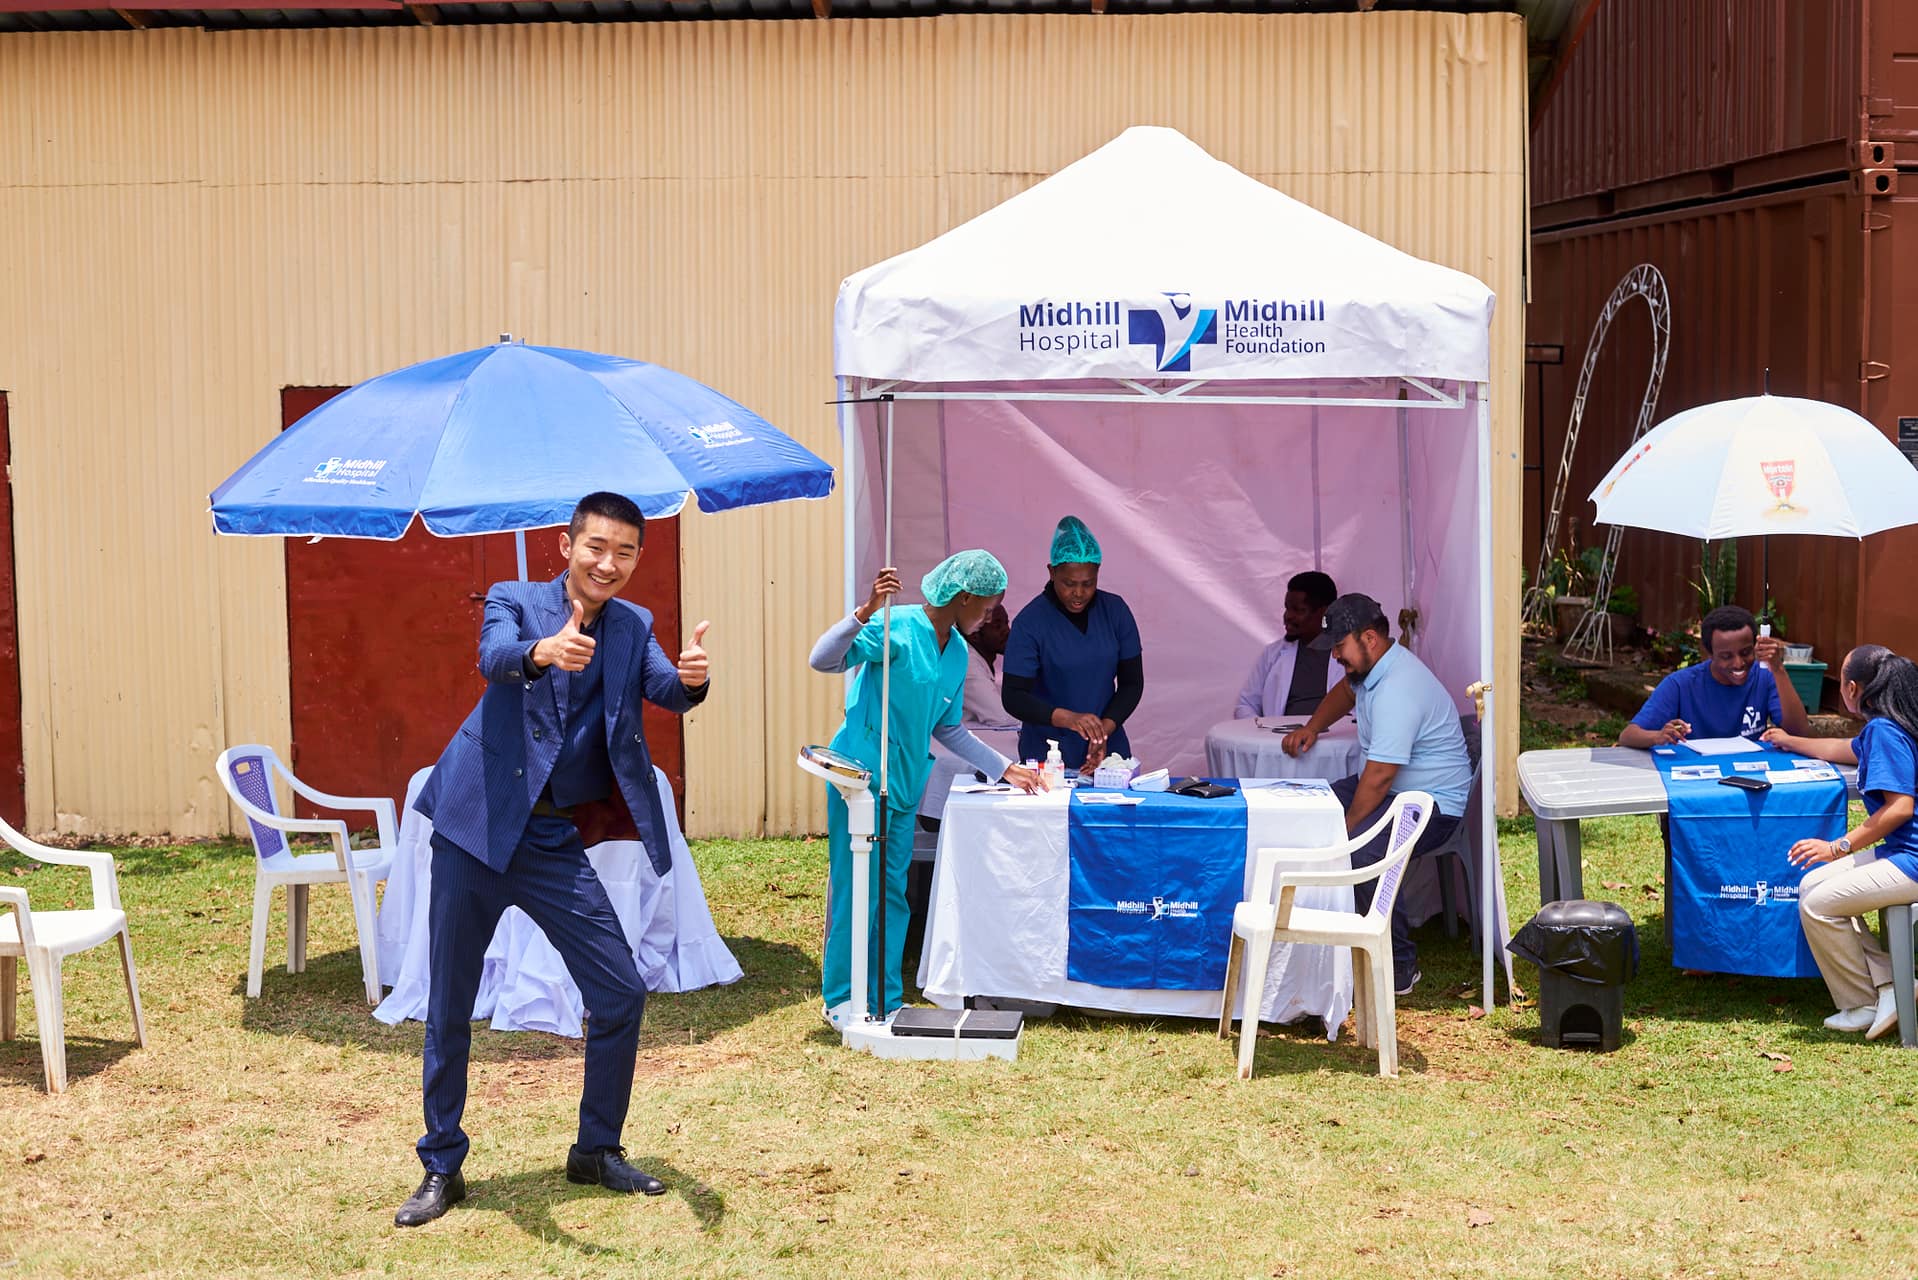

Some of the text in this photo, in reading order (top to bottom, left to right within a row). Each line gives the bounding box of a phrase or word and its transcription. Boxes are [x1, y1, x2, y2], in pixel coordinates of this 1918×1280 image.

[1019, 301, 1120, 328] Midhill
[1225, 299, 1324, 321] Midhill
[1225, 322, 1283, 338] Health
[1019, 329, 1119, 356] Hospital
[1225, 338, 1326, 354] Foundation
[342, 459, 387, 470] Midhill
[336, 468, 380, 479] Hospital
[1720, 885, 1749, 893] Midhill
[1773, 886, 1799, 894] Midhil
[1720, 892, 1749, 900] Hospital
[1117, 900, 1145, 909] Midhill
[1170, 901, 1199, 910] Midhill
